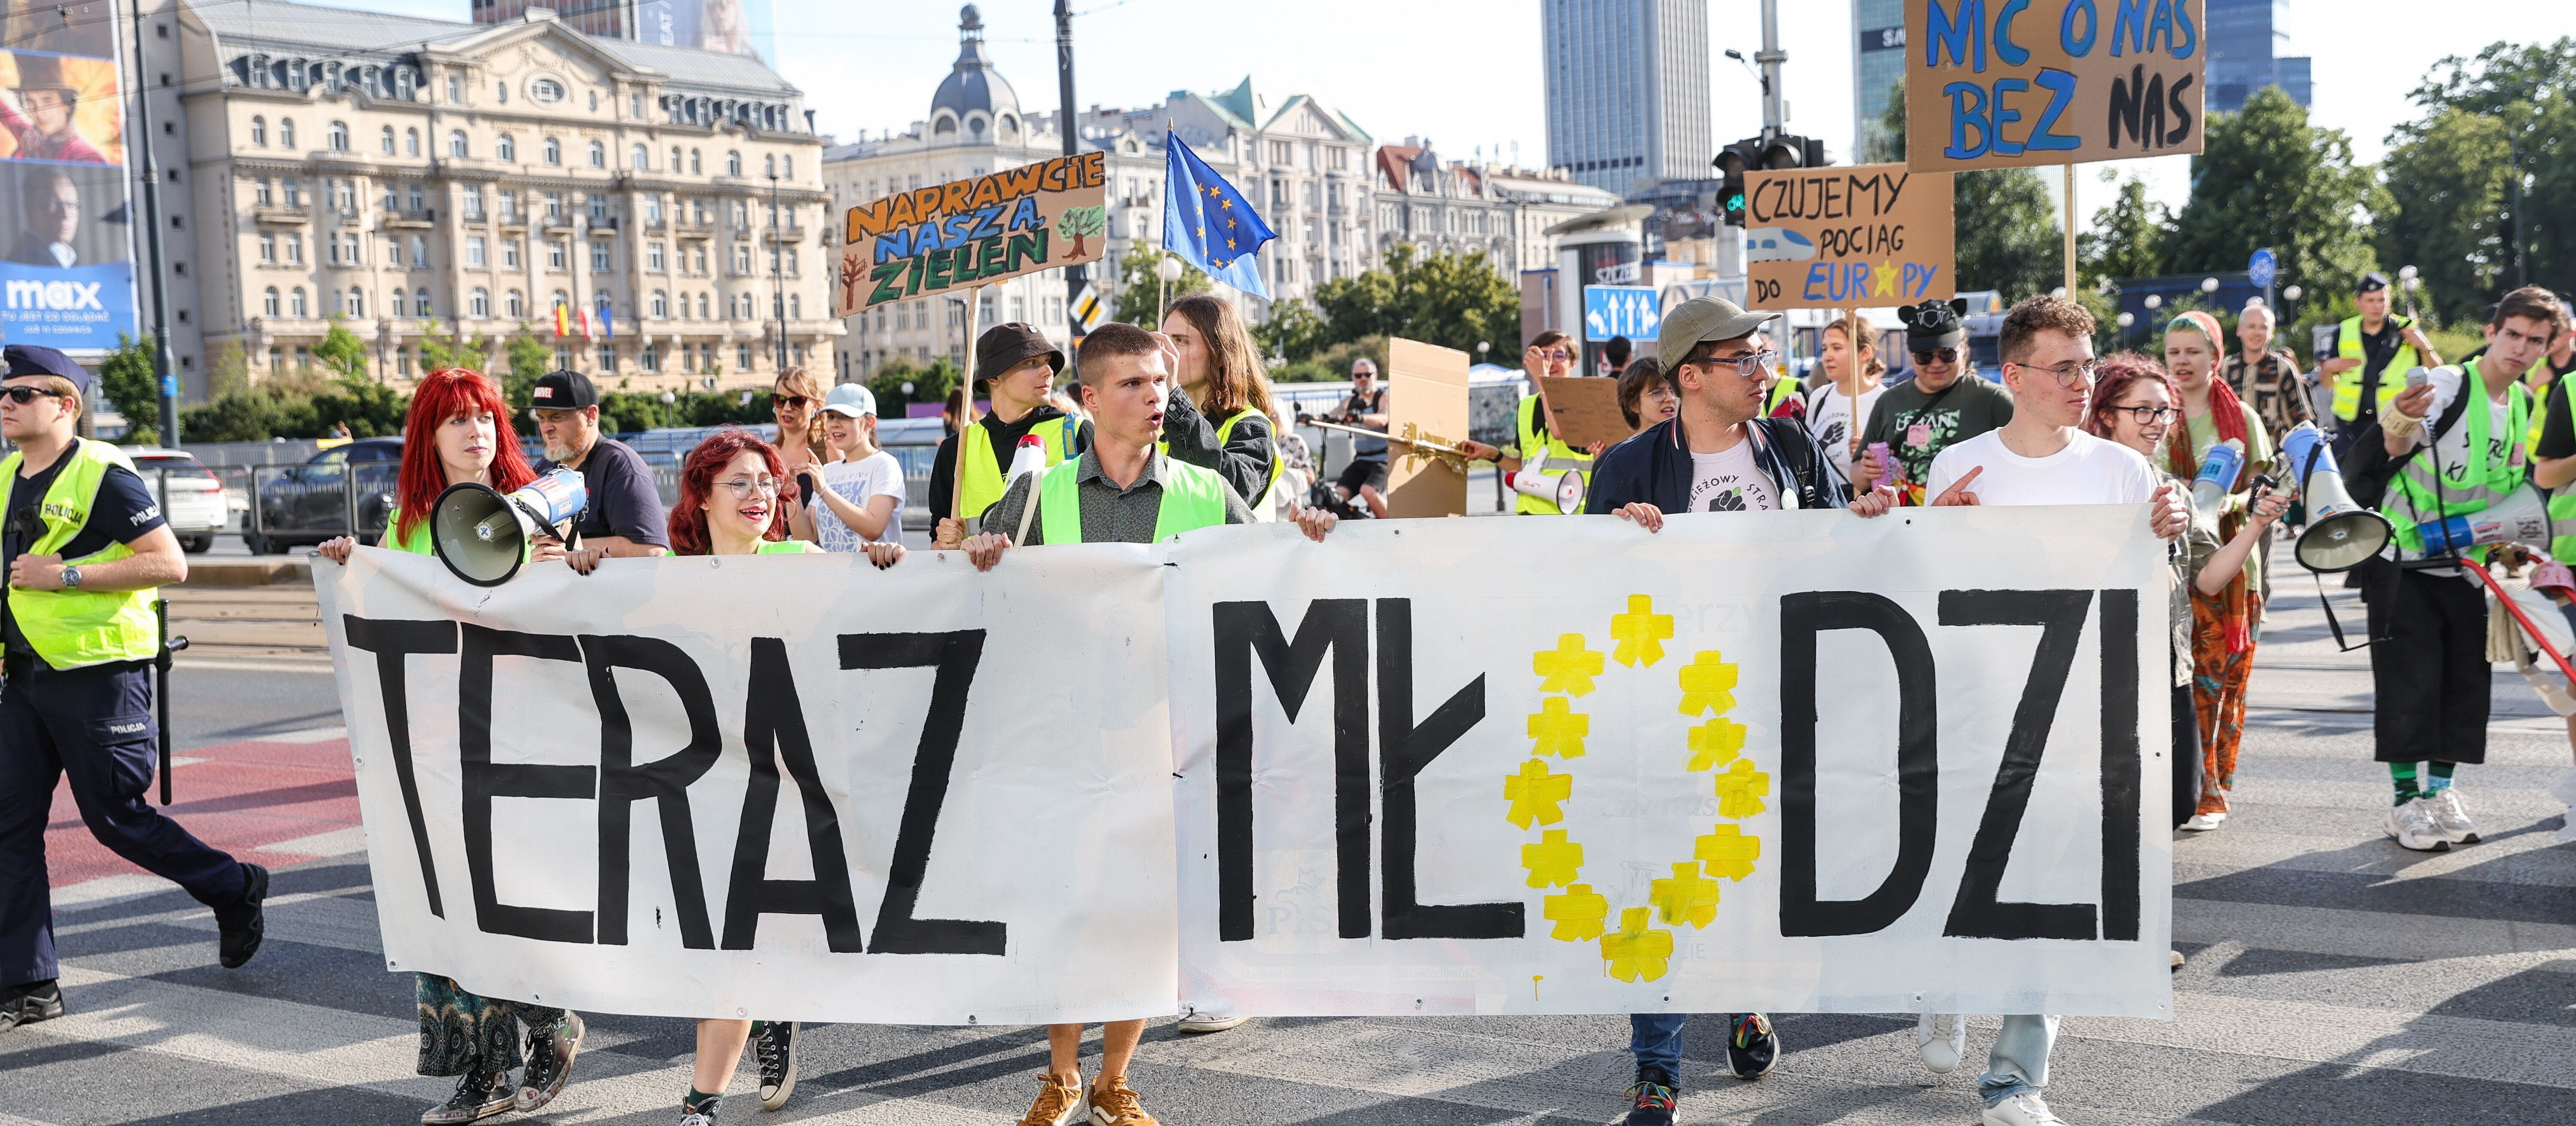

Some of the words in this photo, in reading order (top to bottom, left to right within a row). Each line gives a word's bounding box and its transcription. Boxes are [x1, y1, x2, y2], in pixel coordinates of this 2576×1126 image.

[1926, 0, 2030, 73] NIC
[2061, 0, 2096, 57] O
[2110, 0, 2196, 59] NAS
[1943, 67, 2081, 159] BEZ
[2108, 64, 2193, 151] NAS
[1752, 173, 1908, 222] CZUJEMY
[6, 279, 104, 311] max
[1755, 279, 1780, 303] DO
[44, 504, 83, 525] POLICJA
[110, 722, 146, 734] POLICJA
[343, 613, 1007, 956] TERAZ
[1212, 588, 2142, 983] MŁODZI
